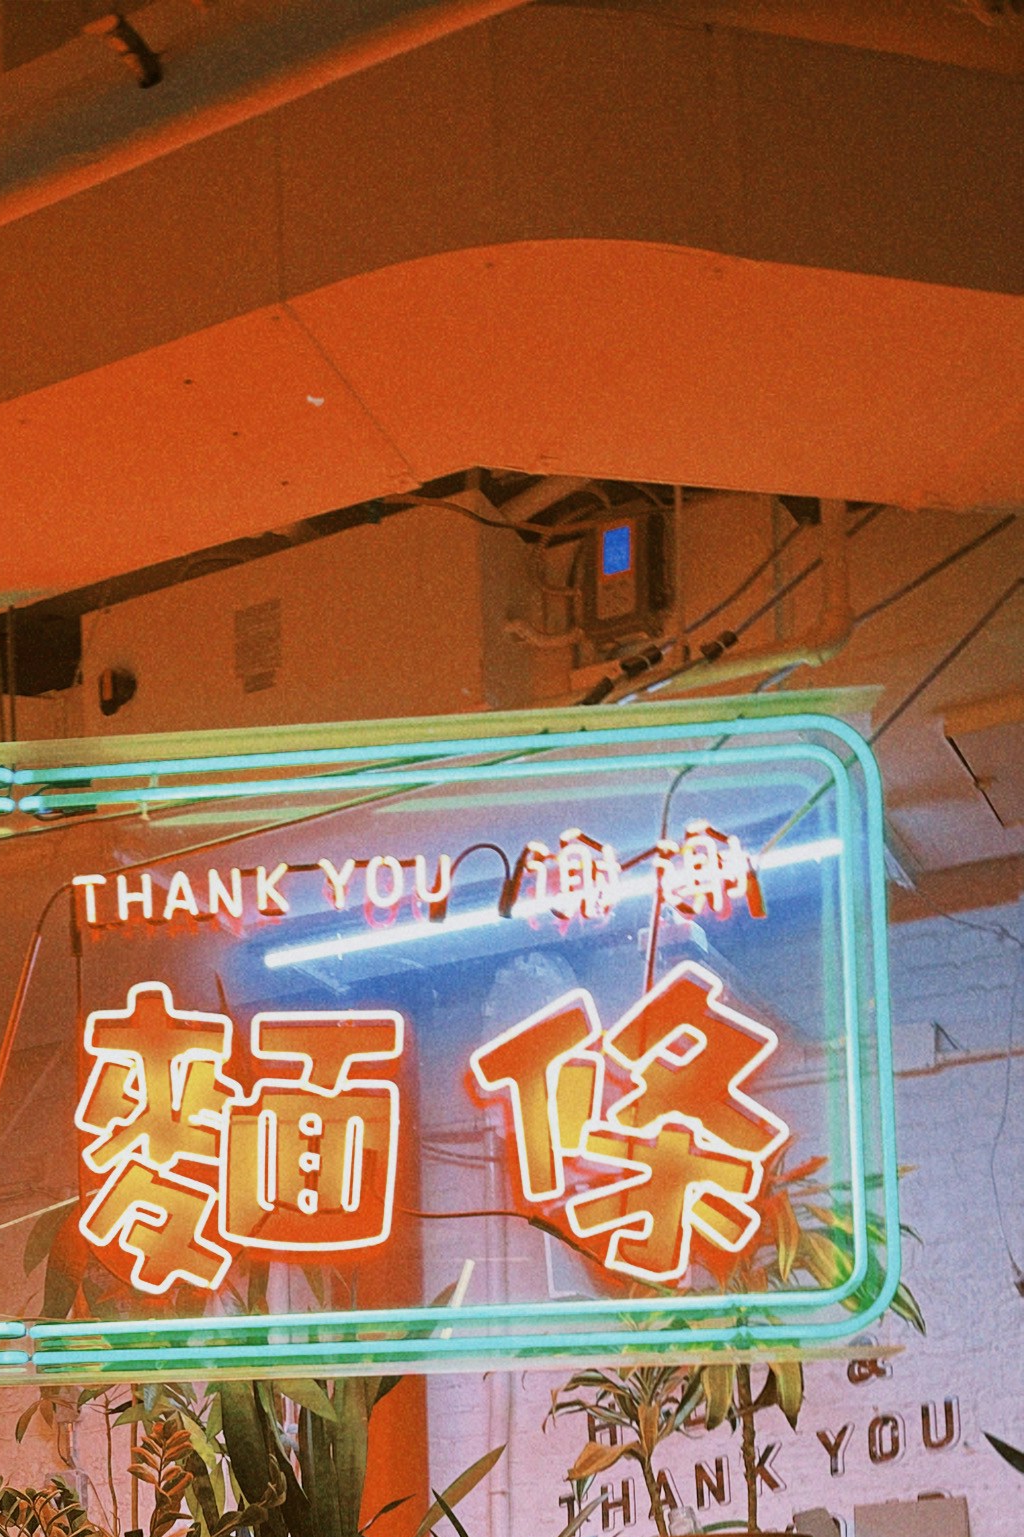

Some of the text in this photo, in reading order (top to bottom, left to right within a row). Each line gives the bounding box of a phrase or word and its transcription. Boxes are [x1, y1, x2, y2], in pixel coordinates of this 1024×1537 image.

[72, 852, 453, 925] THANK YOU
[816, 1394, 960, 1477] YOU
